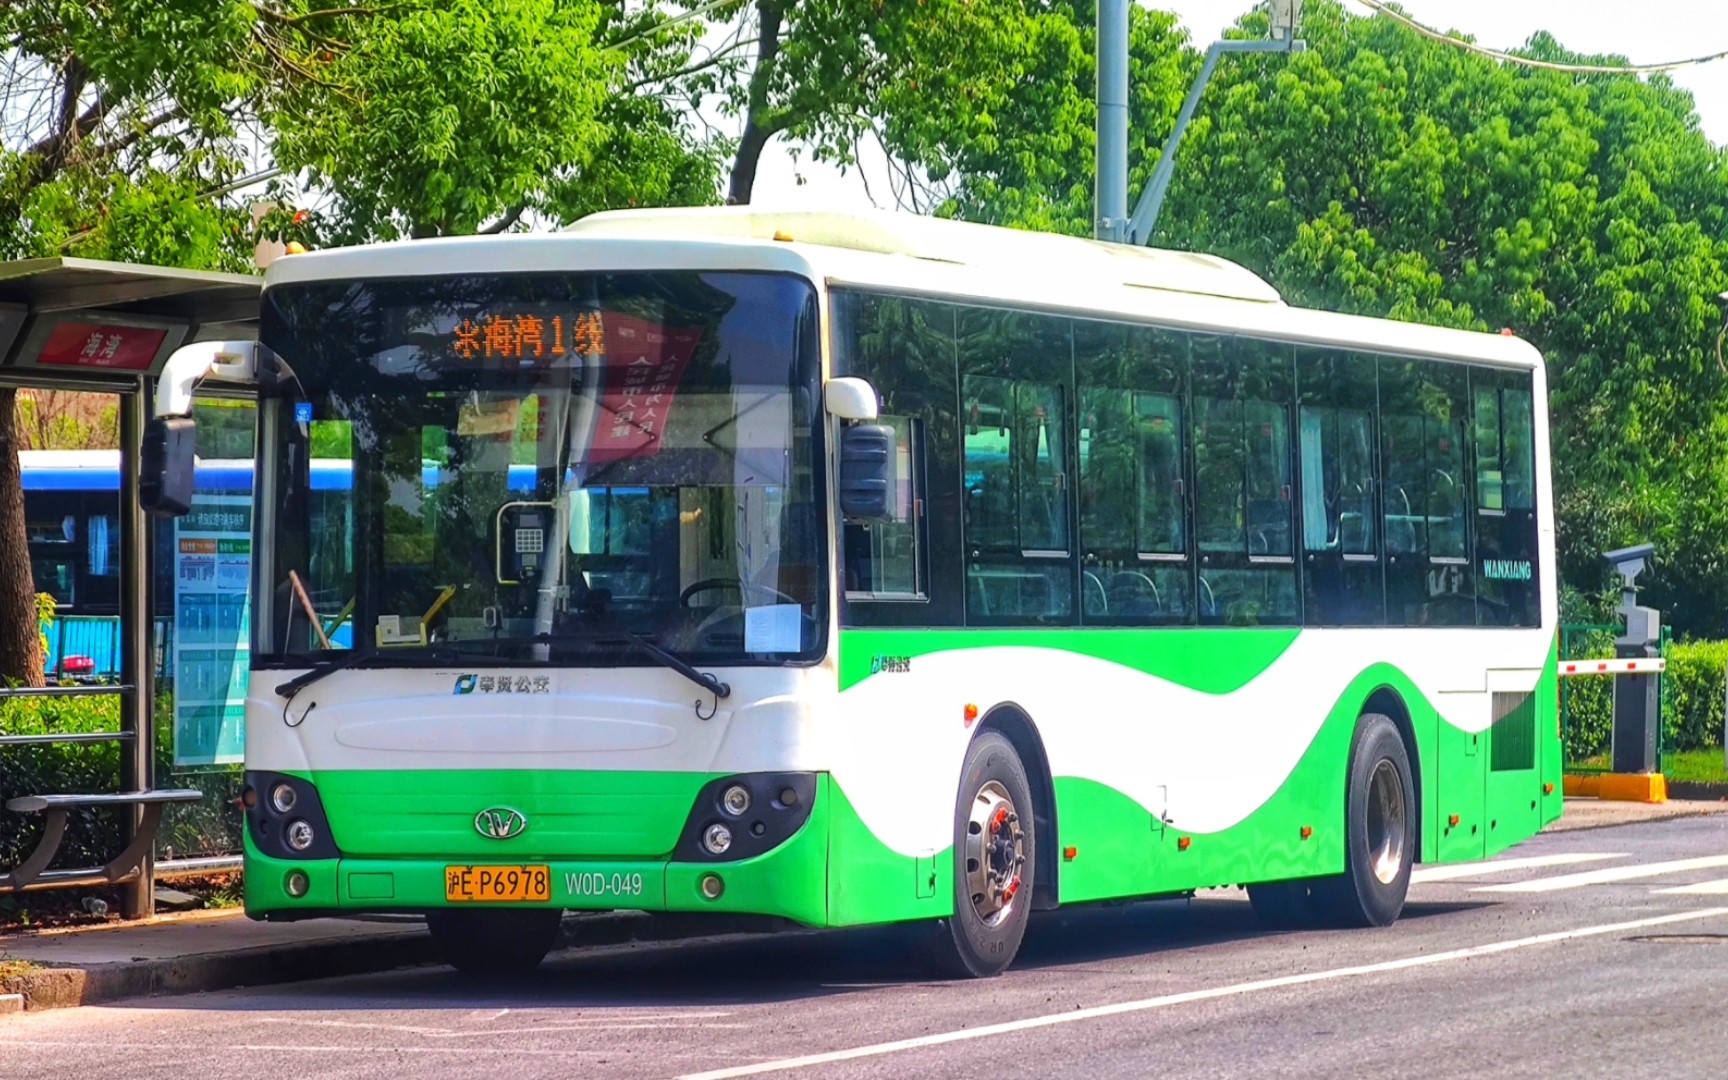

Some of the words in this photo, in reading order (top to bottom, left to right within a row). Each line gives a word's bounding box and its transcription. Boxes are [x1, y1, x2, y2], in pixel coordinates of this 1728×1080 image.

[80, 332, 123, 358] 海湾
[1483, 559, 1531, 580] WANXIANG
[479, 675, 550, 694] 奉贤公交
